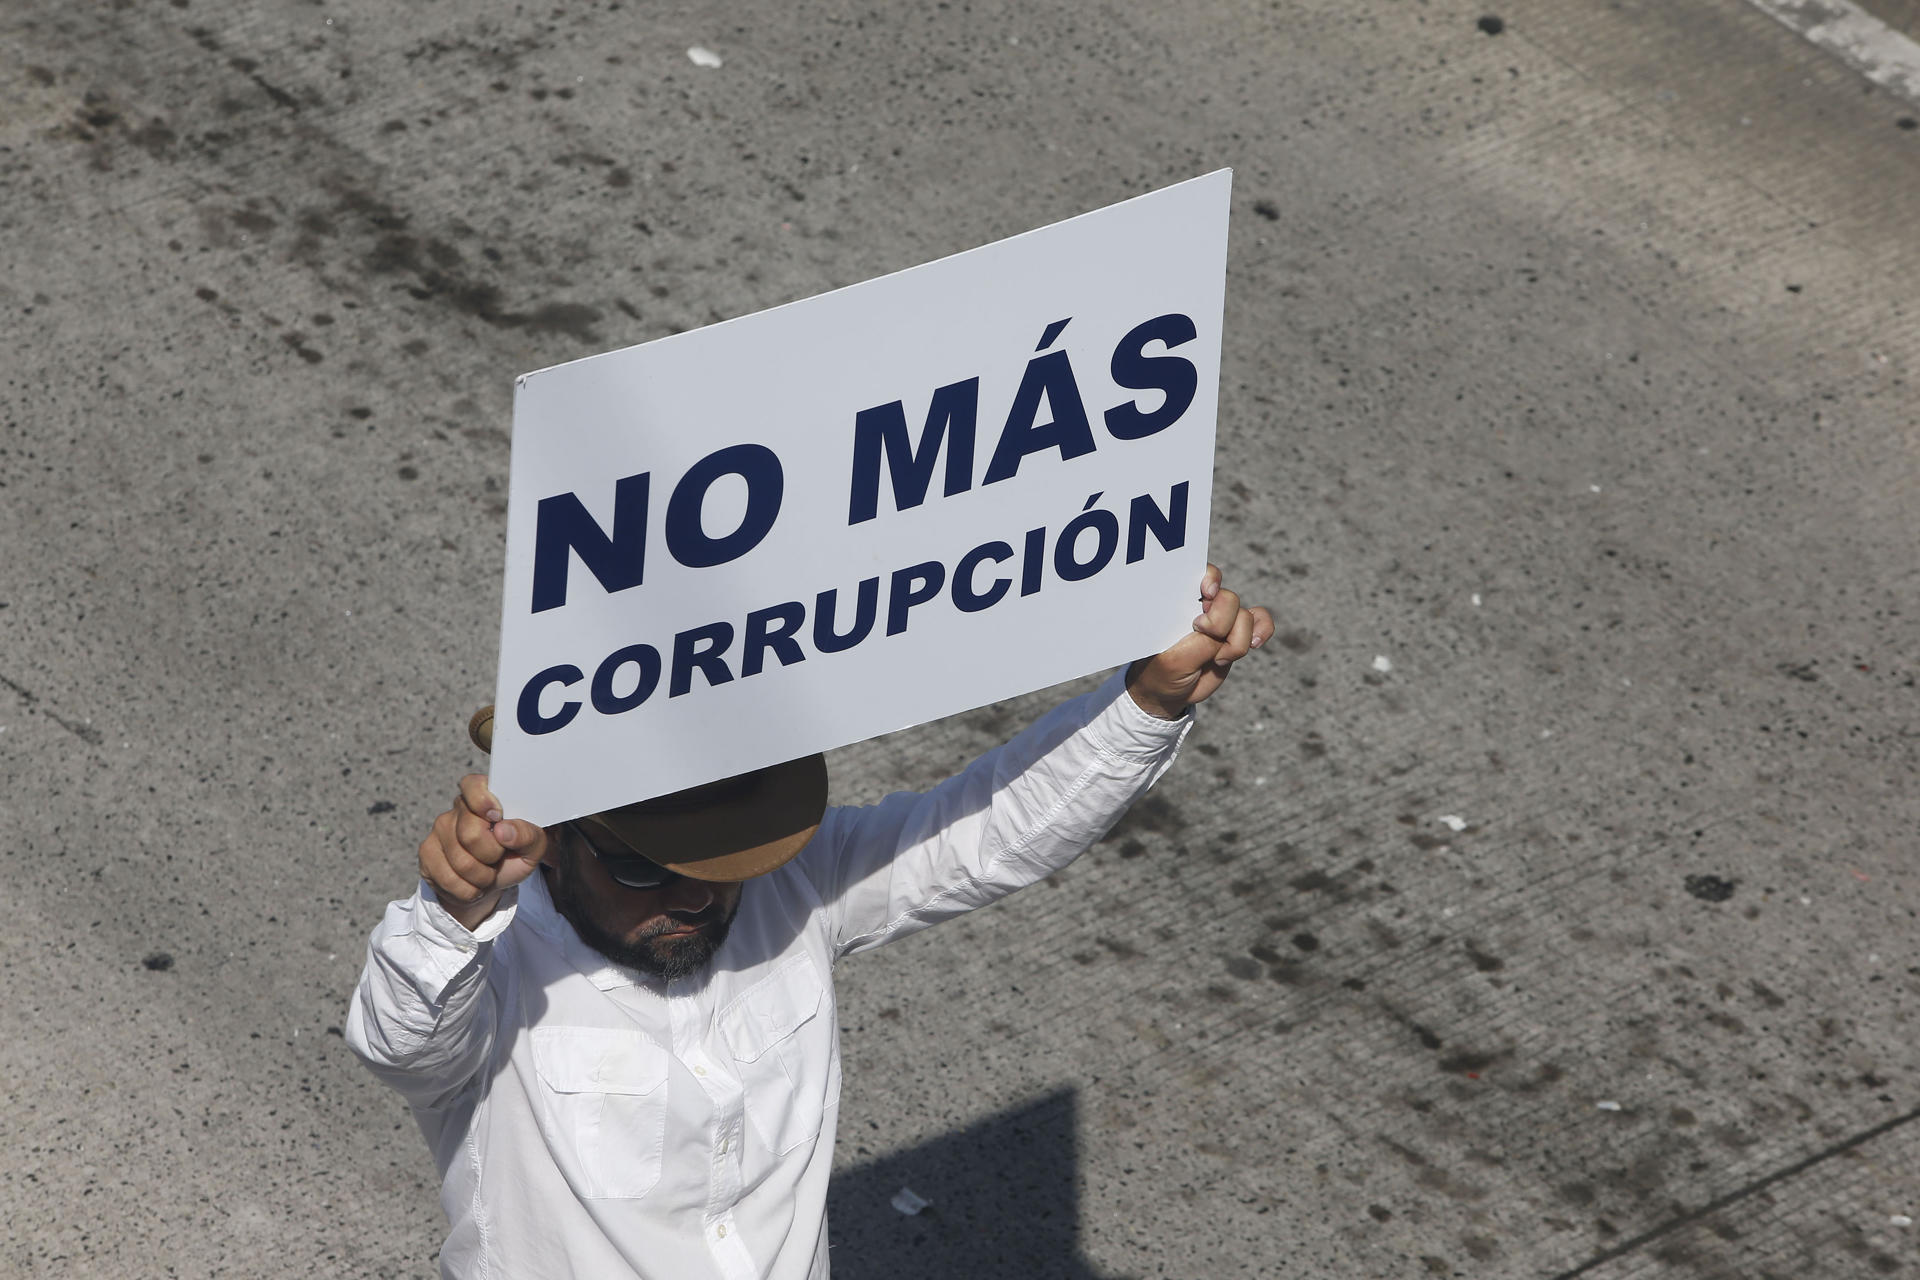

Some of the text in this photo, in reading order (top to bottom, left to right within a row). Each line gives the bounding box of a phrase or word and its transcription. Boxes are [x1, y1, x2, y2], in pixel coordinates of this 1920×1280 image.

[531, 313, 1199, 614] NO MÁS
[516, 480, 1191, 735] CORRUPCIÓN
